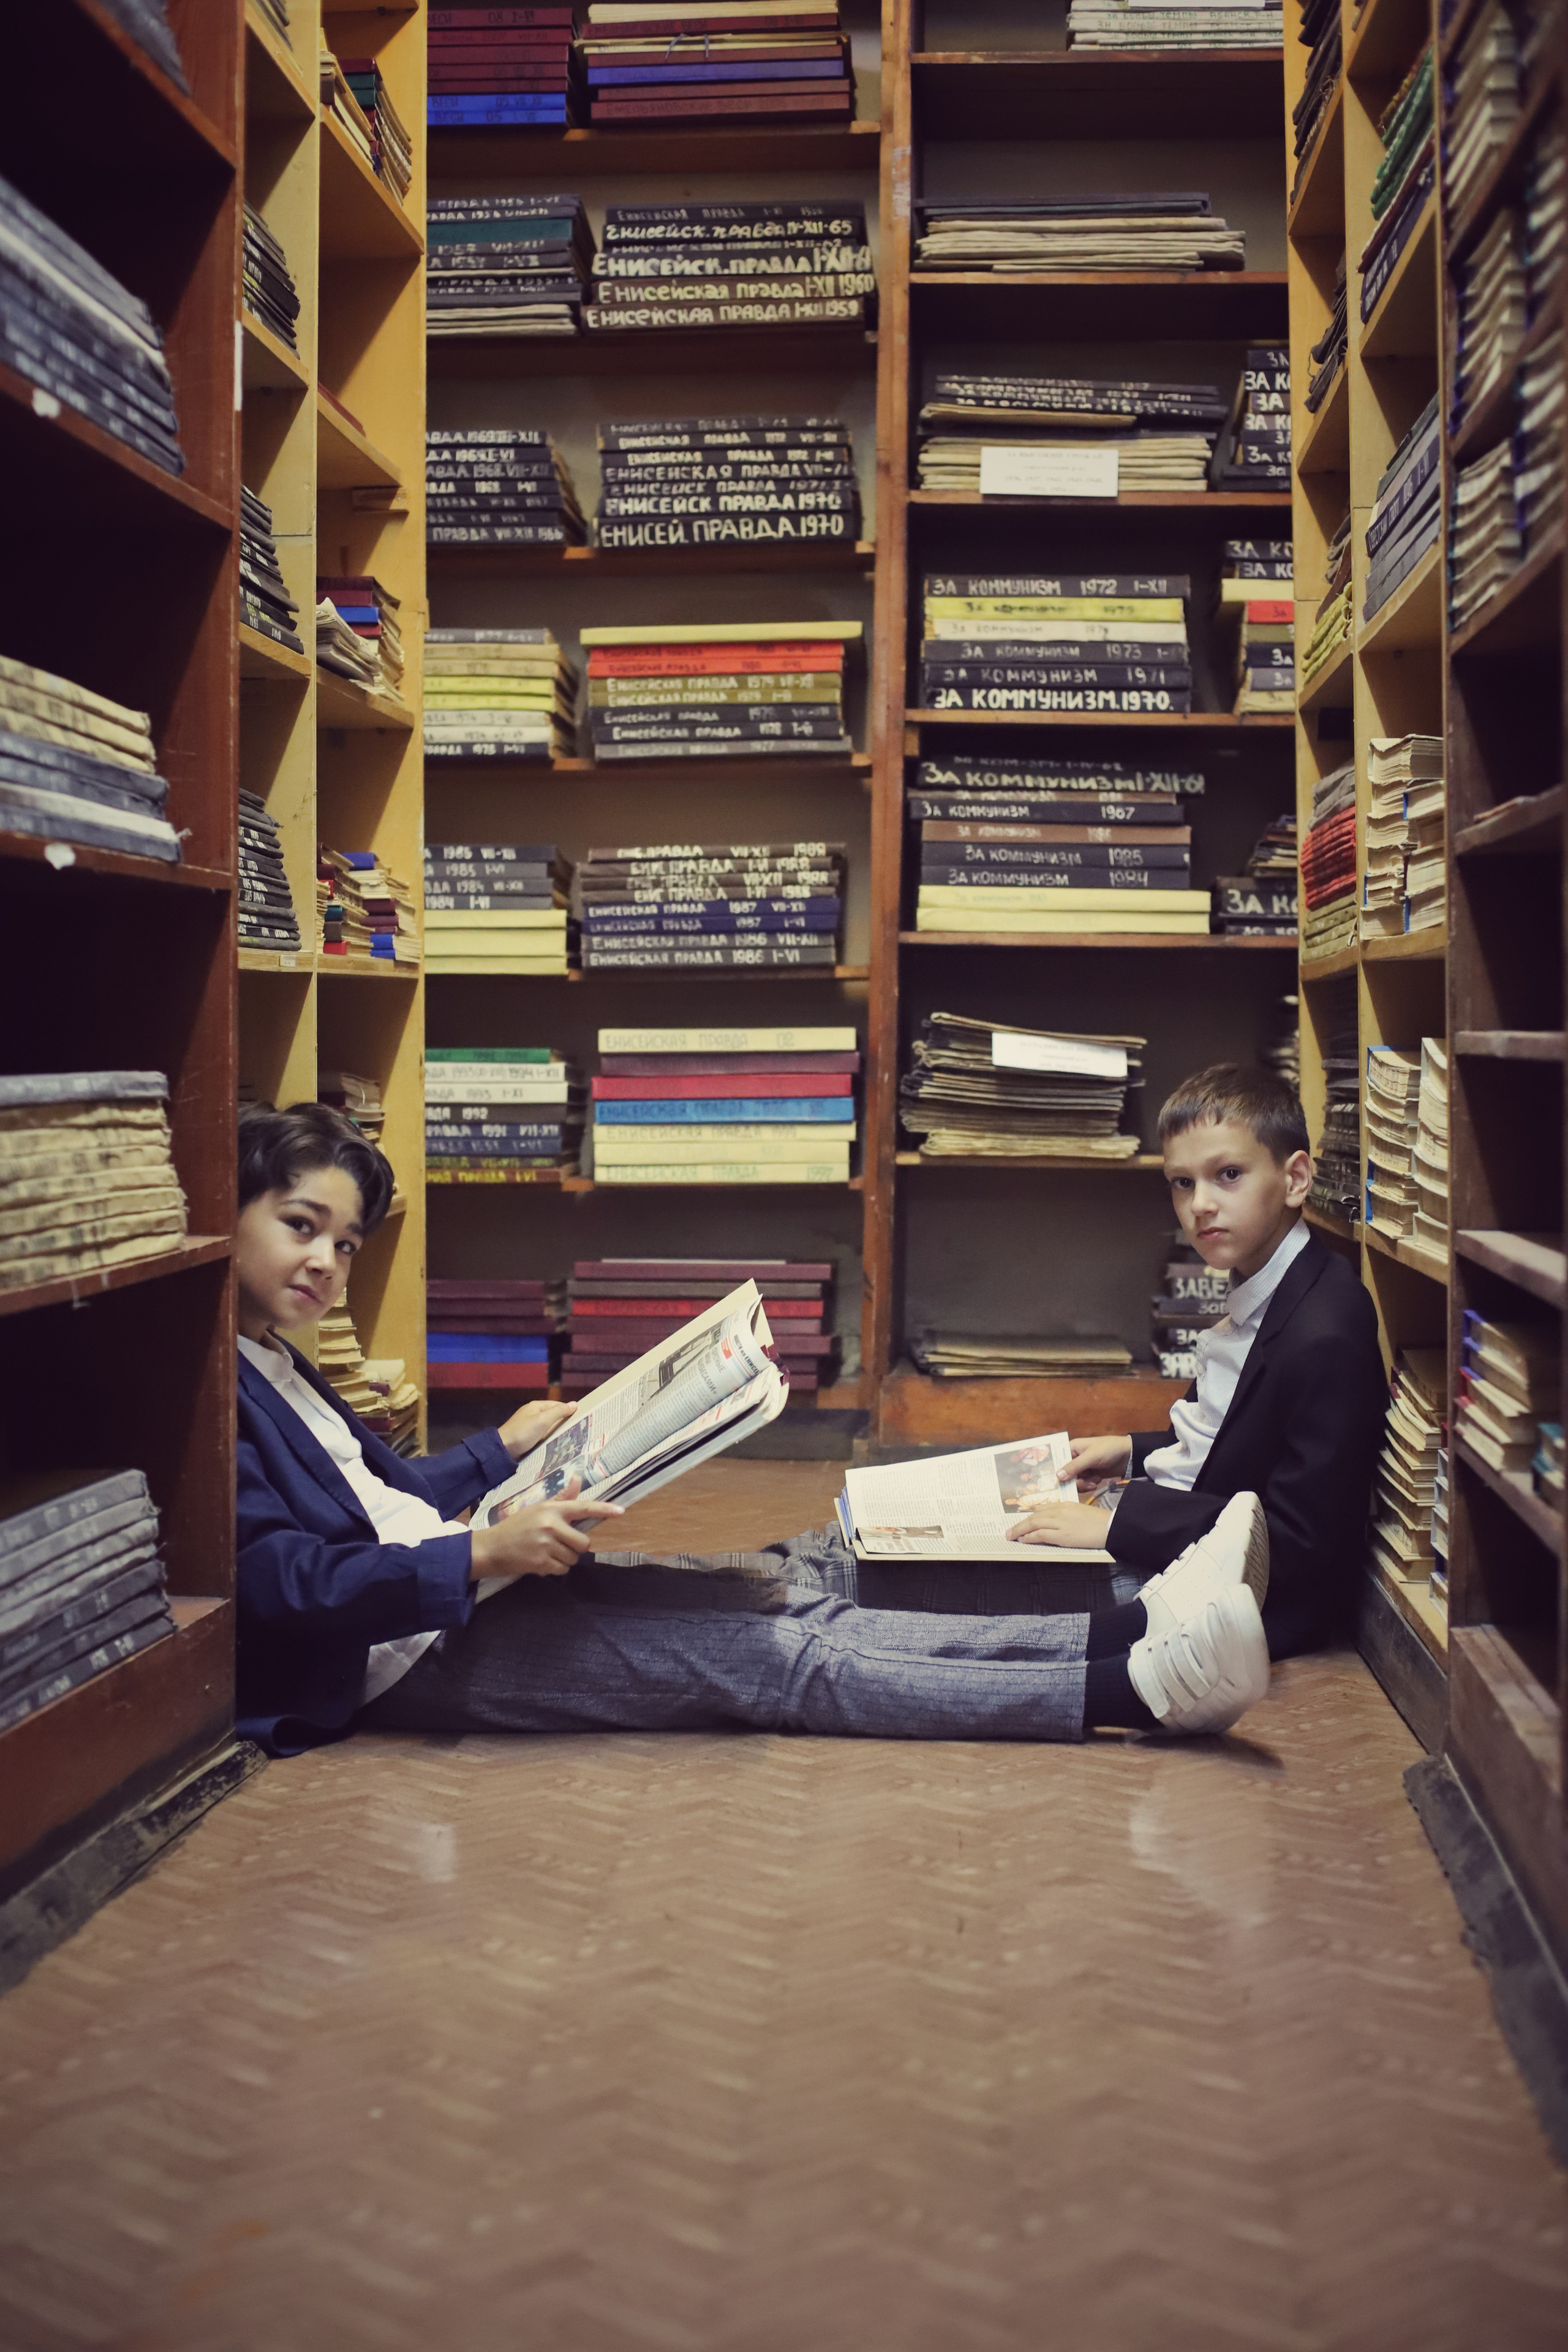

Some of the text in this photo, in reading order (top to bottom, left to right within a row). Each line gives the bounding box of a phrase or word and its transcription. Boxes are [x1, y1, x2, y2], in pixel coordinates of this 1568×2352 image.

[839, 273, 875, 296] 1960
[1244, 371, 1270, 391] ЗА
[1256, 393, 1284, 412] ЗА
[1244, 413, 1268, 431] ЗА
[718, 493, 796, 513] ПРАВДА
[693, 516, 796, 543] ПРАВДА
[799, 513, 845, 538] 1970
[1227, 540, 1259, 559] ЗА
[1243, 562, 1267, 578] ЗА
[932, 579, 957, 595] ЗА
[968, 579, 1061, 596] КОММУНИЗМ
[1079, 578, 1118, 596] 1972
[960, 643, 984, 659] ЗА
[943, 668, 968, 682] ЗА
[981, 669, 1098, 684] КОММУНИЗМ
[933, 688, 964, 709] ЗА
[921, 761, 961, 785] ЗА
[921, 800, 1136, 820] ЗА КОММУНИЗМ 1967
[966, 844, 985, 861] ЗА
[948, 868, 968, 885] ЗА
[972, 870, 1069, 886] КОММУНИЗМ
[1227, 889, 1265, 914] ЗА
